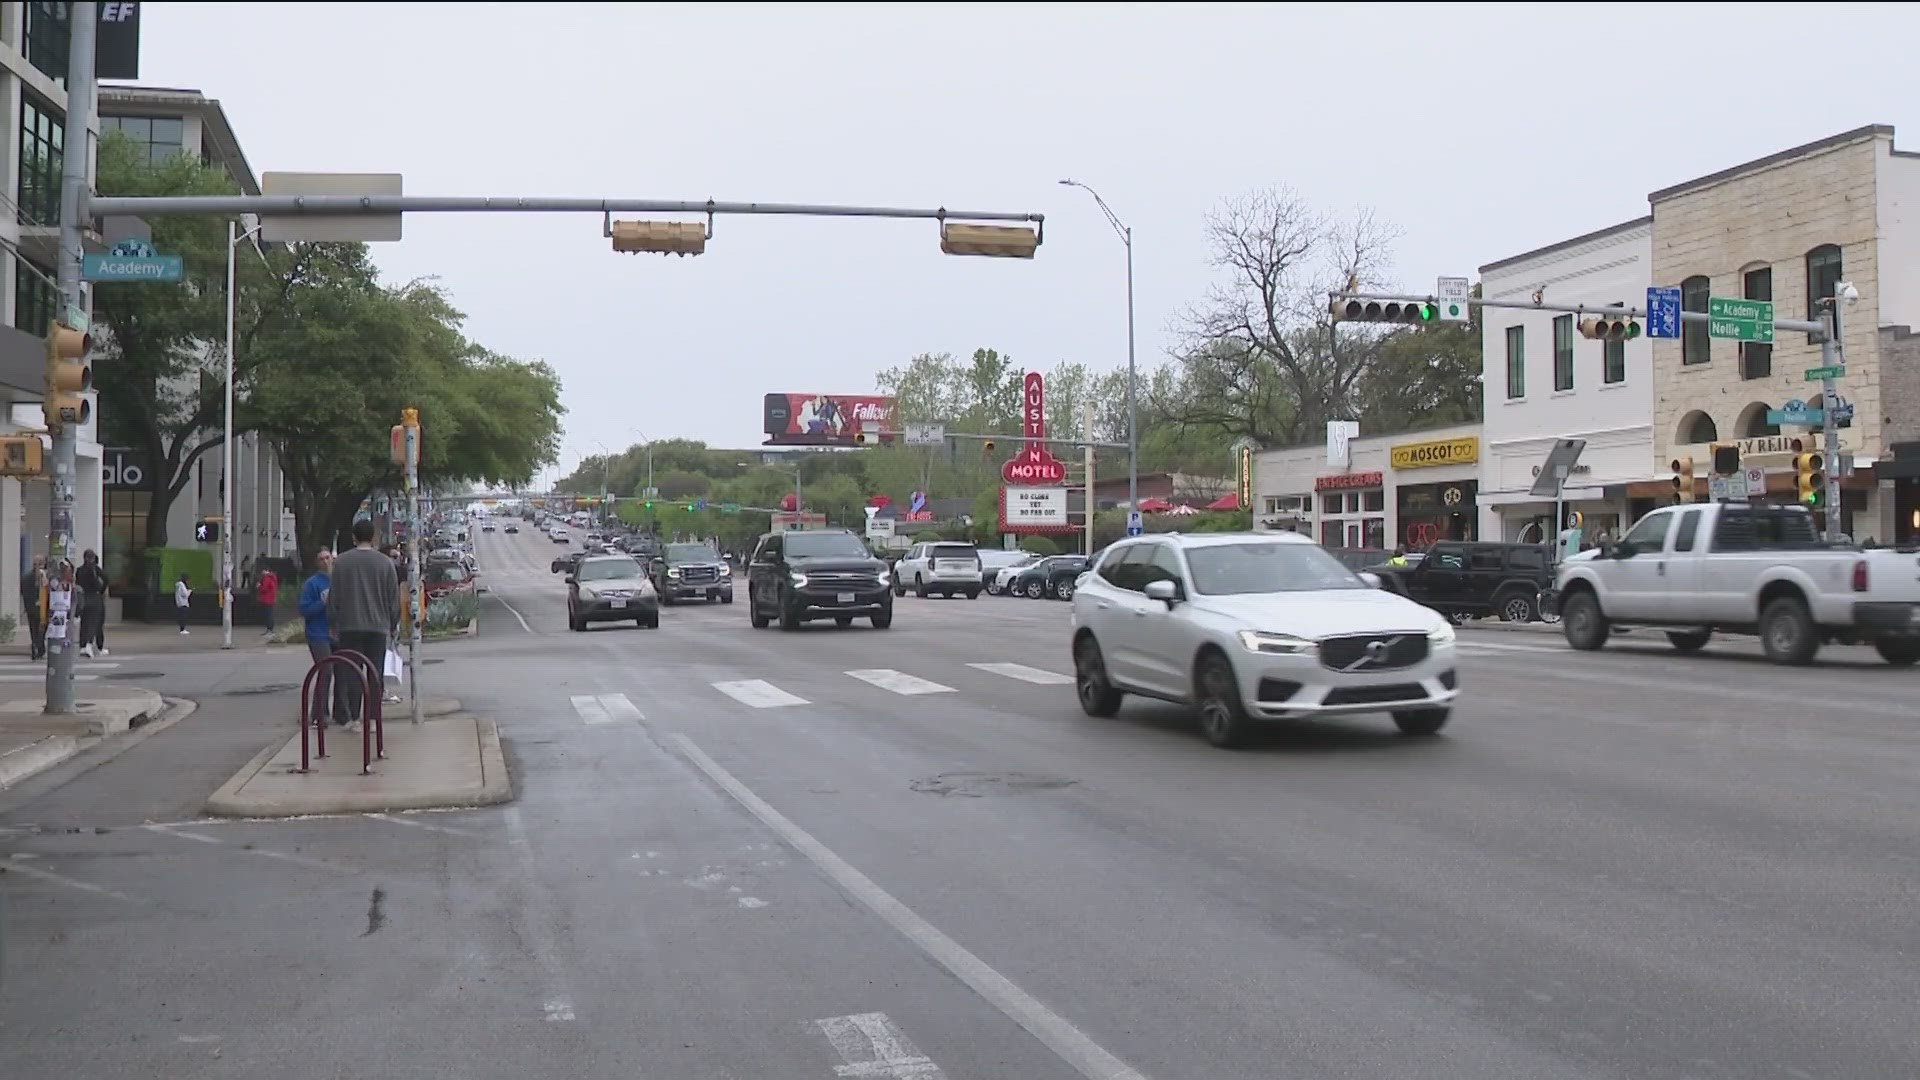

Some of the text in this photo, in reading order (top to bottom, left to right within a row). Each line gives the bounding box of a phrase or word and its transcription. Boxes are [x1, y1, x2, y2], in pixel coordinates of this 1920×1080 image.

[101, 2, 136, 22] EF
[98, 260, 166, 278] Academy
[1722, 302, 1760, 320] Academy
[1711, 321, 1740, 336] Nellie
[852, 402, 894, 421] Fallout
[1029, 379, 1041, 462] AUSTIN
[1410, 444, 1452, 463] MOSCOT
[103, 453, 142, 484] alo
[1011, 465, 1059, 478] MOTEL
